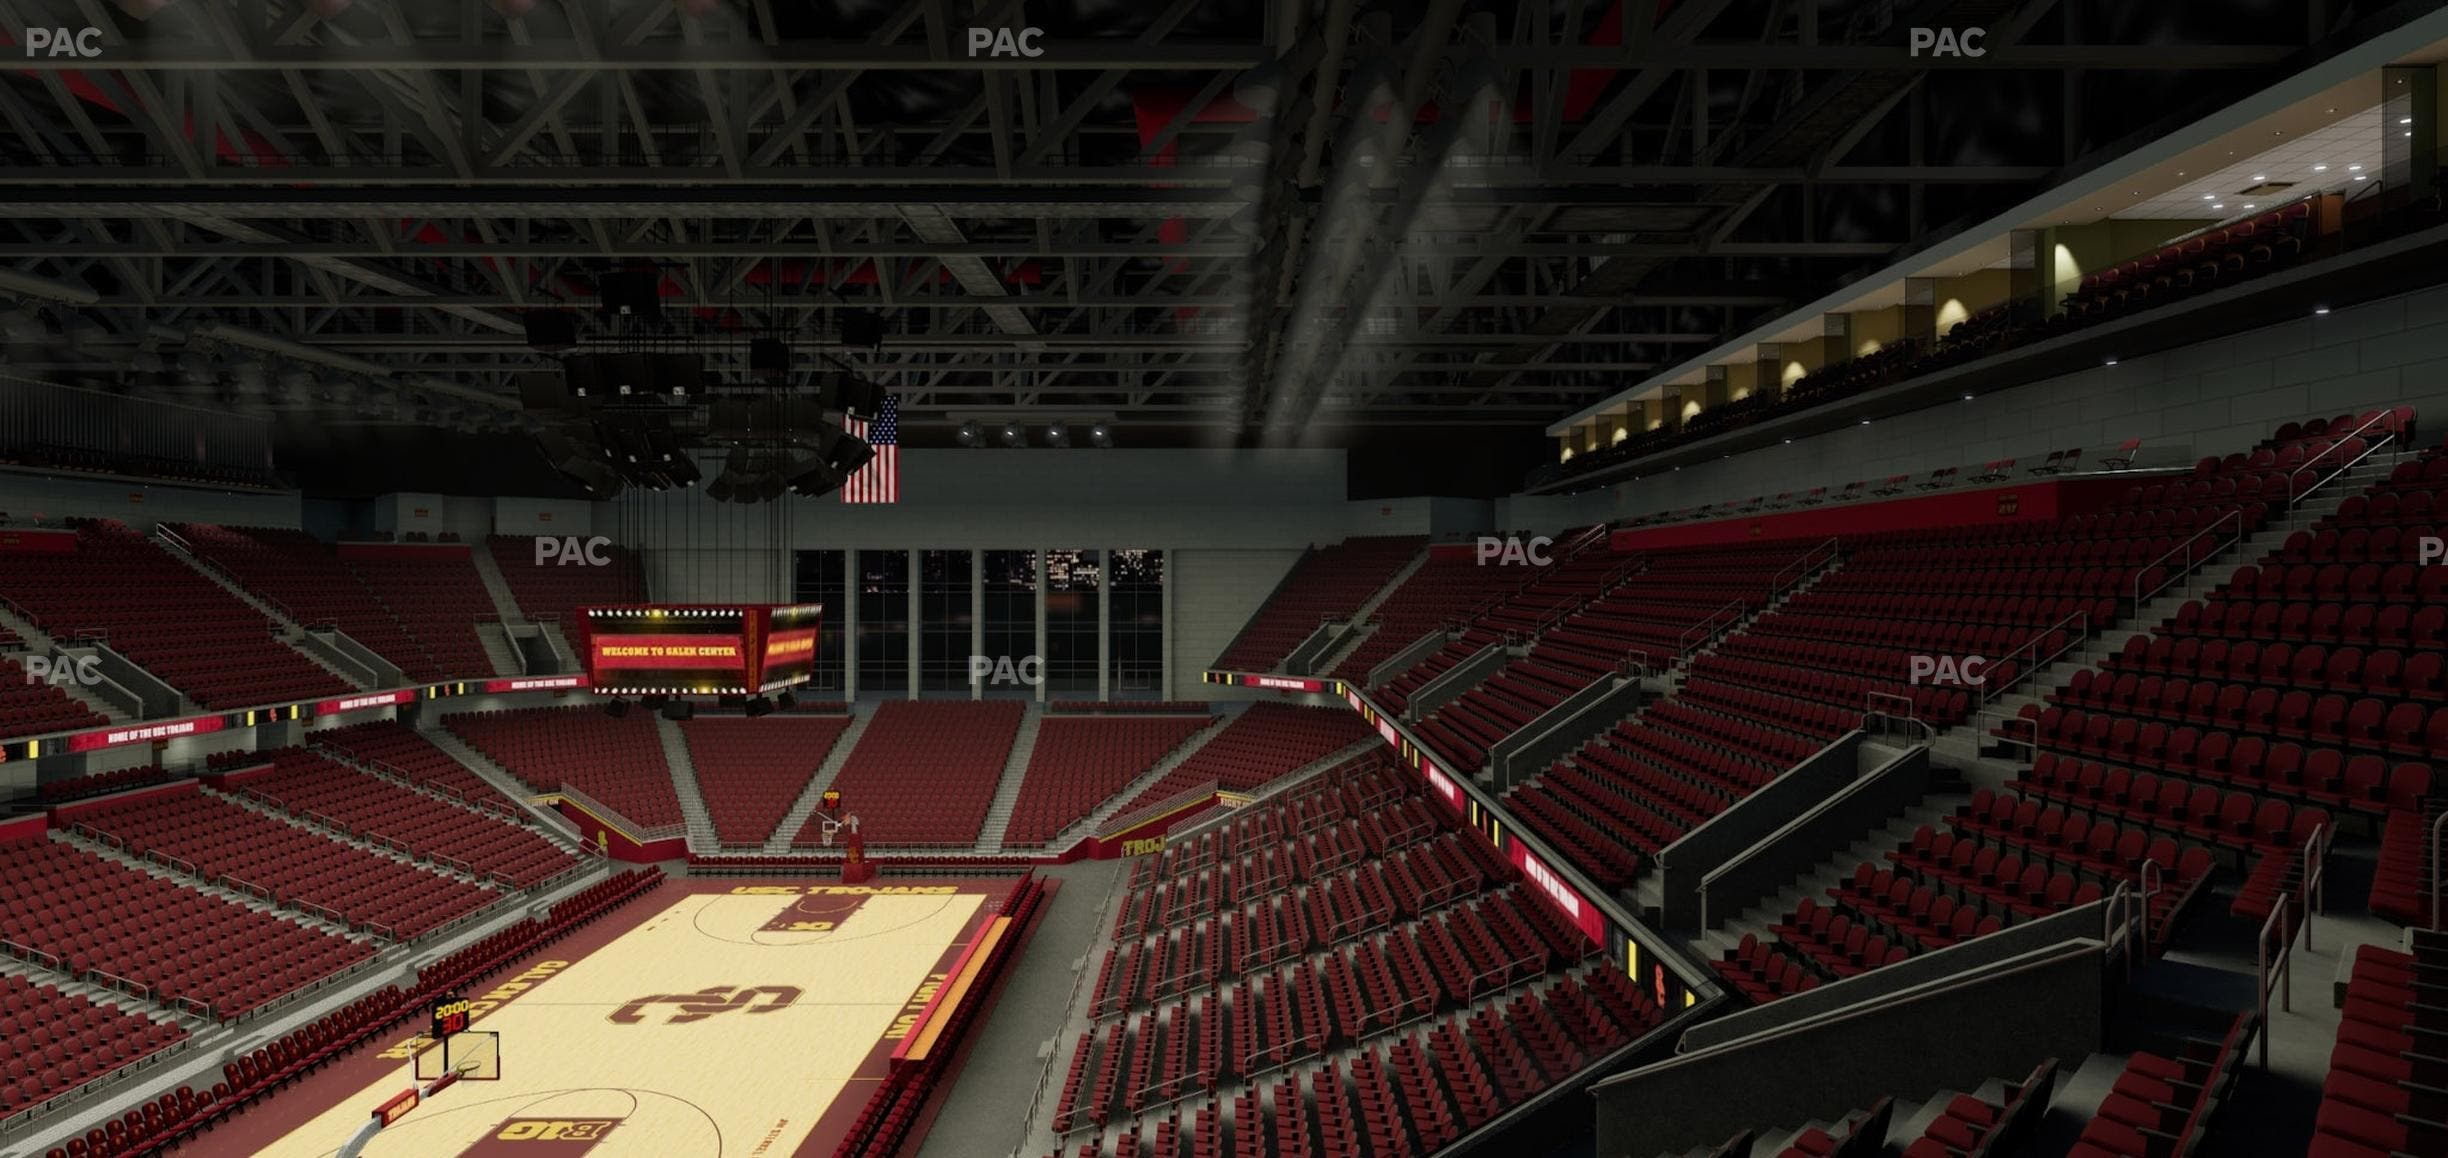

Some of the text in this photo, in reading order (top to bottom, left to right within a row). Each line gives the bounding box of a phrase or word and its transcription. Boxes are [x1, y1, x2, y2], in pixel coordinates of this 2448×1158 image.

[602, 647, 649, 656] WELCOME
[650, 647, 664, 656] TO
[698, 647, 736, 656] CENTER
[108, 731, 129, 744] HOME
[129, 729, 139, 741] OF
[139, 727, 153, 739] THE
[729, 885, 960, 895] USC TROJANS
[435, 999, 470, 1020] 20:00
[442, 1012, 465, 1034] 30
